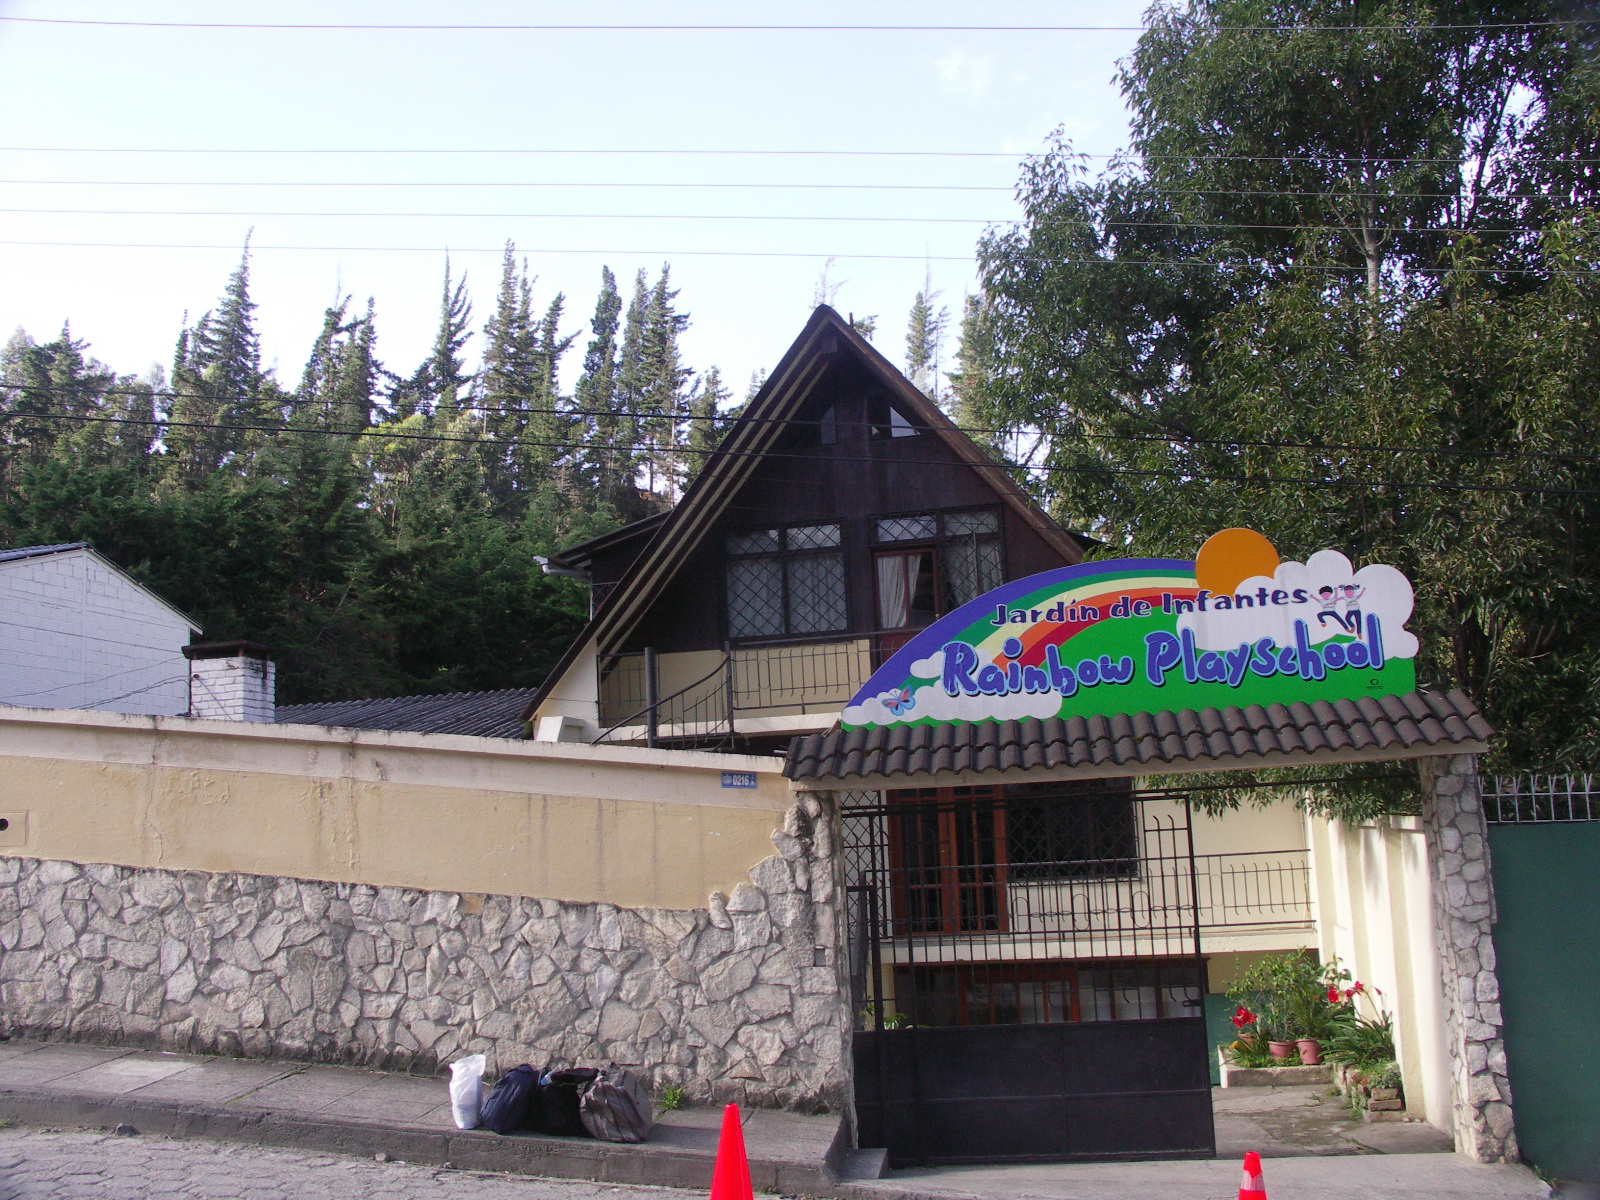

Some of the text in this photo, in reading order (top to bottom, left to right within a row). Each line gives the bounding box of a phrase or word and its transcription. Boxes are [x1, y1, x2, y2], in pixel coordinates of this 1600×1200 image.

[991, 587, 1308, 626] Jardín de Infantes
[941, 637, 1134, 696] Rainbow
